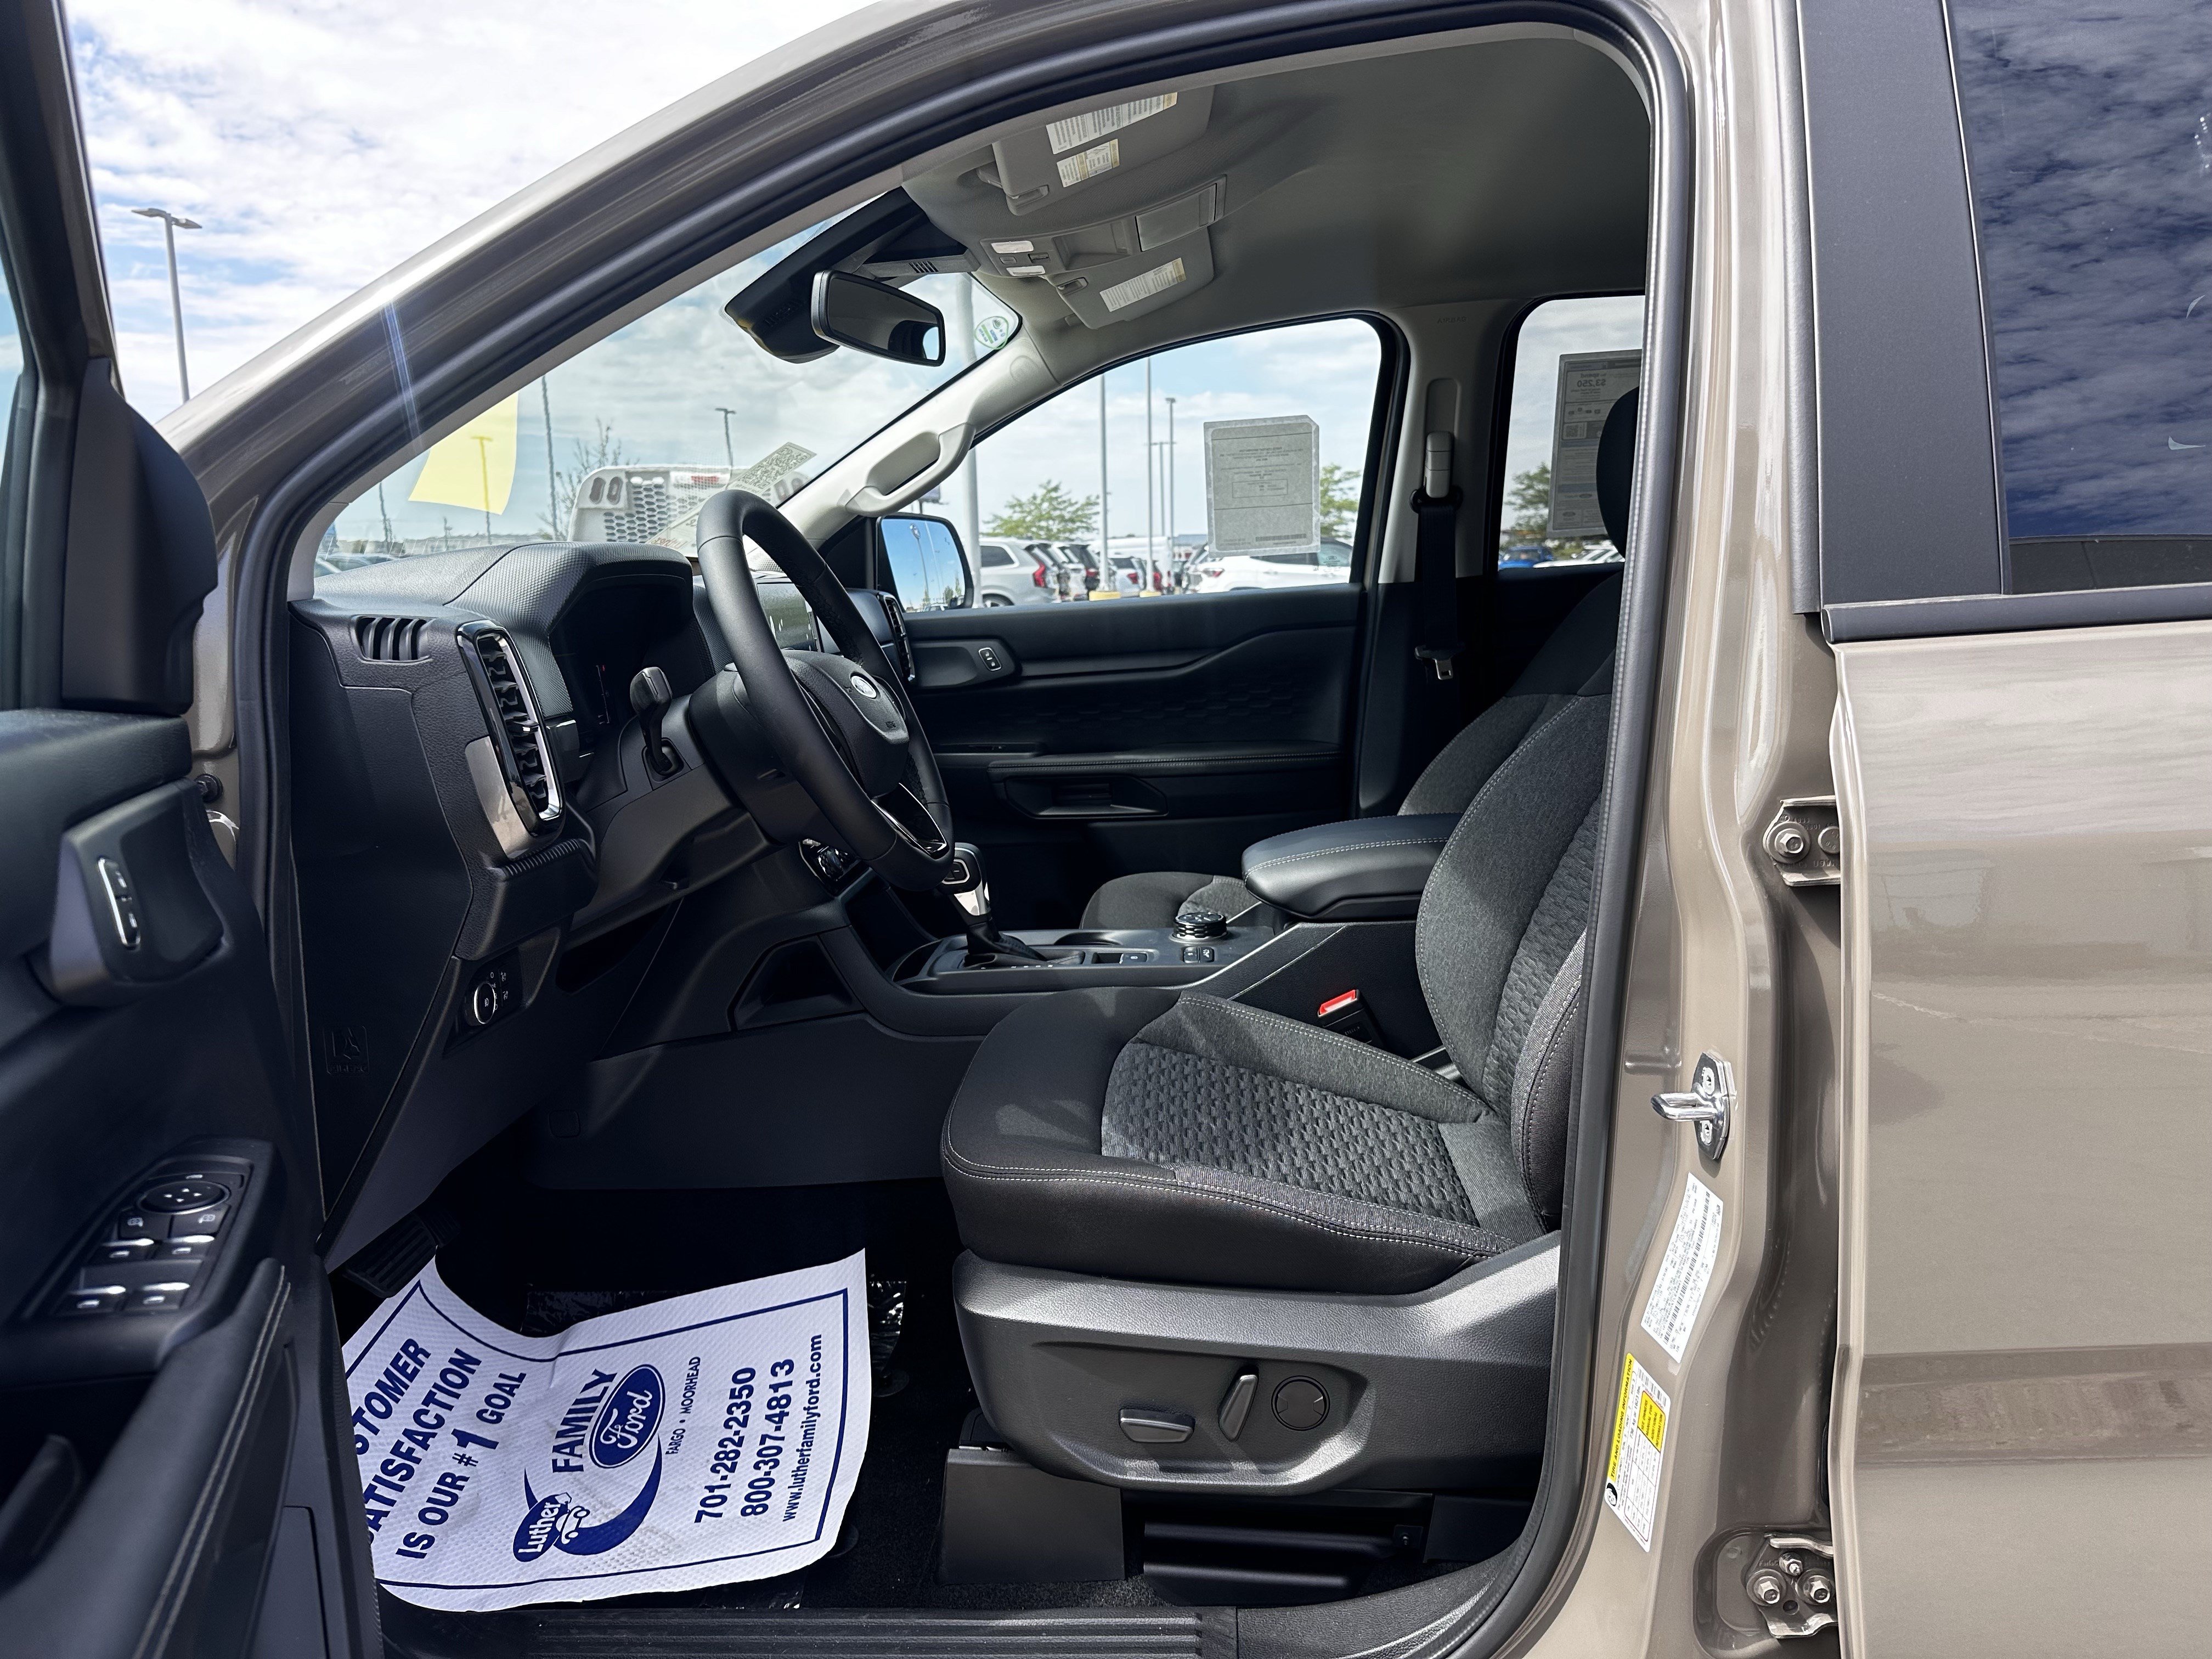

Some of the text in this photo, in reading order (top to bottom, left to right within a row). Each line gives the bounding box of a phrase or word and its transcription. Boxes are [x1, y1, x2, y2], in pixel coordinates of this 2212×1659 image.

[364, 1347, 482, 1545] ATISFACTION
[395, 1531, 436, 1559] IS
[417, 1471, 471, 1526] OUR
[476, 1372, 527, 1425] GOAL
[551, 1368, 618, 1473] FAMILY
[600, 1390, 653, 1449] Ford
[665, 1356, 701, 1455] FARGO MOORHEAD
[694, 1367, 757, 1523] 701-282-2350
[740, 1358, 795, 1517] 800-307-4813
[782, 1334, 822, 1522] www.lutherfamilyford.com
[1616, 1410, 1624, 1444] LOADING
[1622, 1358, 1632, 1410] INFORMATION
[518, 1502, 561, 1554] Luther
